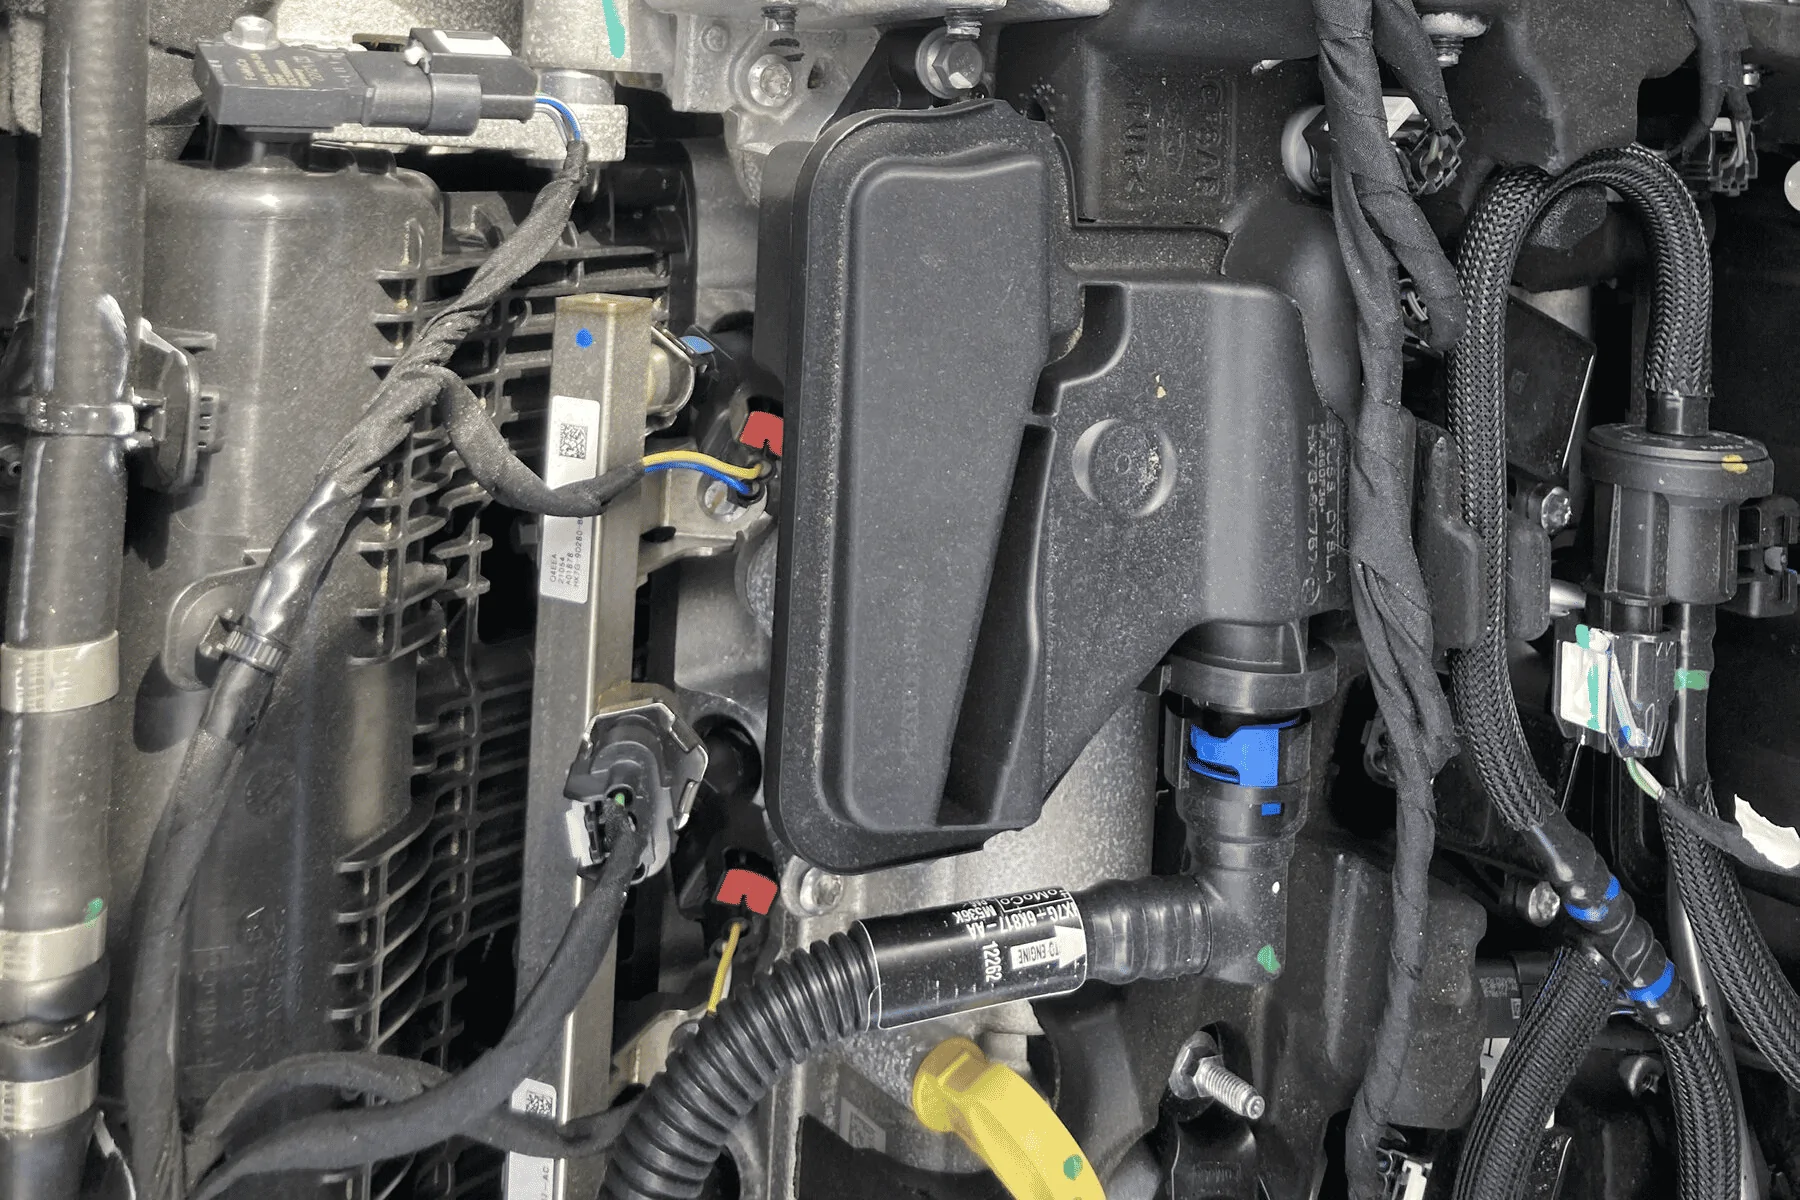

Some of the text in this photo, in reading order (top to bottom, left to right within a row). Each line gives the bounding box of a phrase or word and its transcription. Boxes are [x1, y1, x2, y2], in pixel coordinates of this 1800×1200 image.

[952, 904, 997, 924] M536K
[983, 940, 1003, 983] 12262
[1018, 943, 1046, 963] ENGINE
